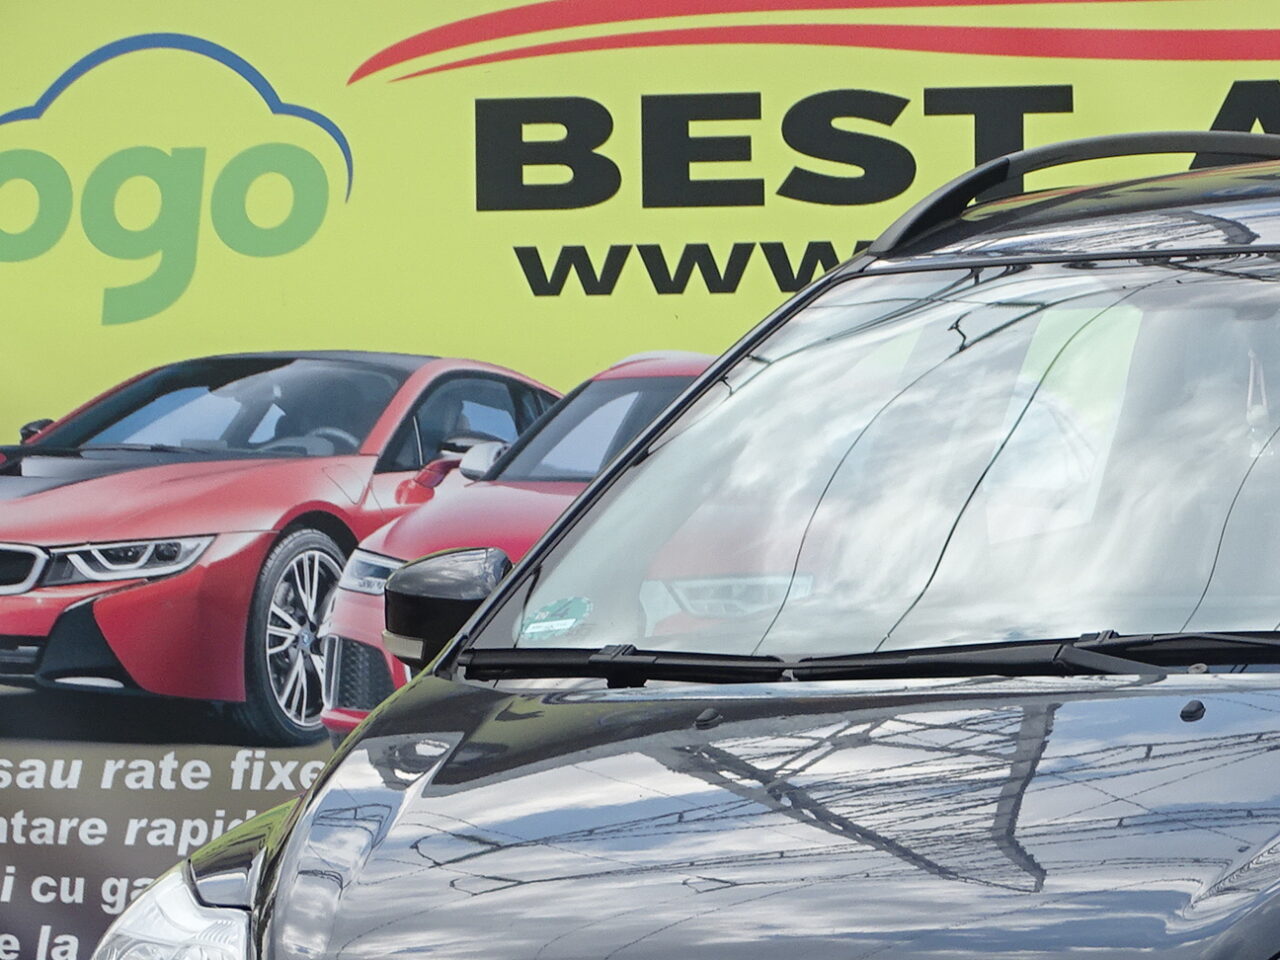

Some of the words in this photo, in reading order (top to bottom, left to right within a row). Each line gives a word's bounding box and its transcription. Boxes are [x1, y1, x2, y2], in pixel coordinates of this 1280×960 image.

[475, 85, 1073, 211] BEST
[100, 751, 212, 790] rate
[0, 809, 108, 846] tare
[124, 810, 256, 855] rapi
[31, 876, 85, 903] cu
